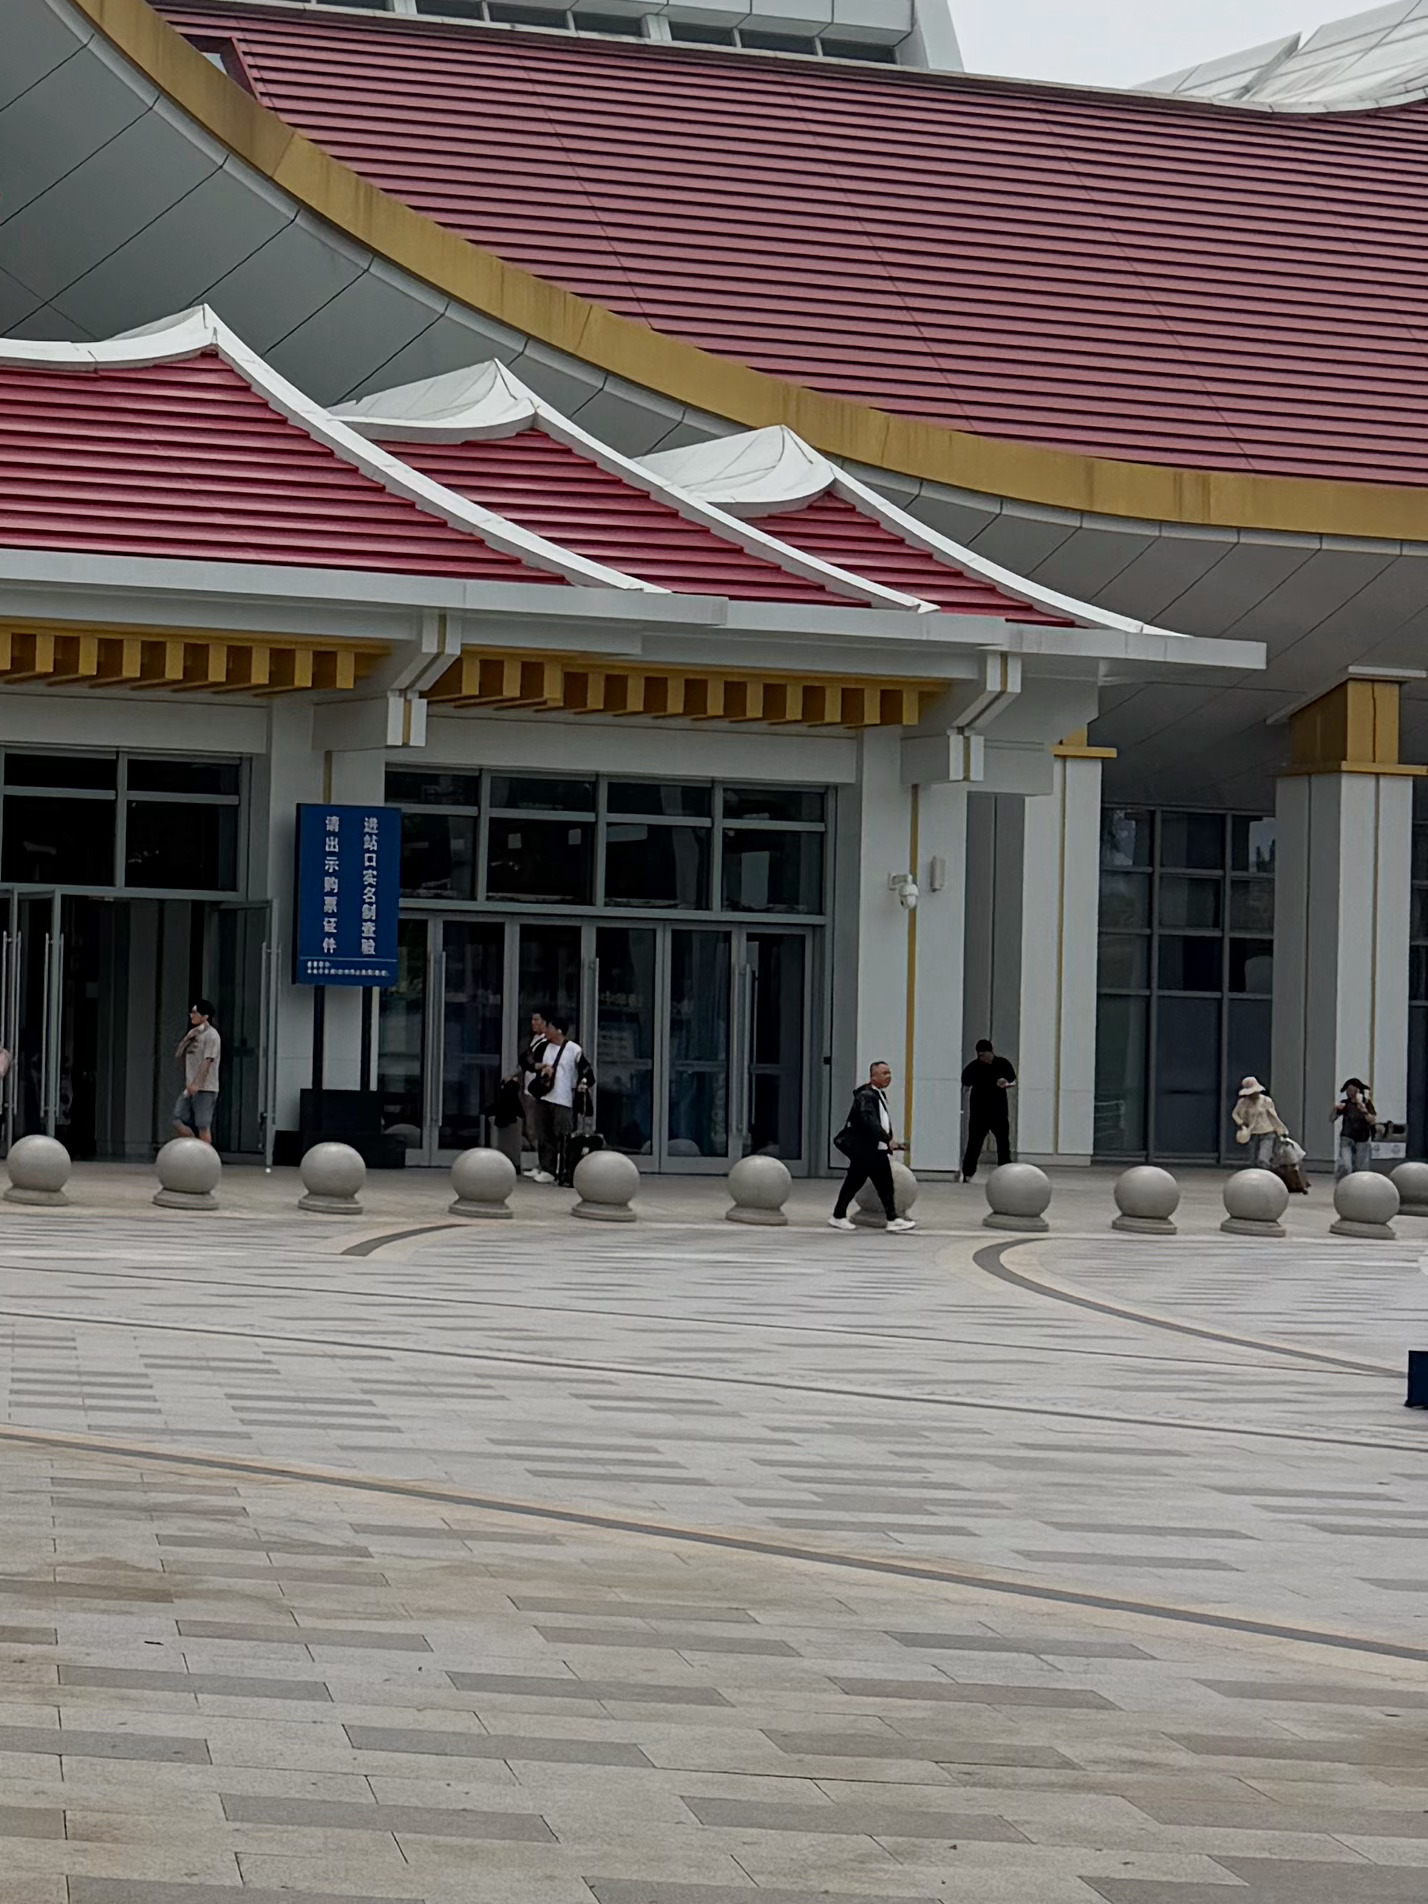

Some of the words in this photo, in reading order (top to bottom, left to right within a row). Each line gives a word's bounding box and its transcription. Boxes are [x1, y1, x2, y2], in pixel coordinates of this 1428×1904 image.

[322, 815, 340, 954] 请出示购票证件
[361, 816, 379, 955] 进站口实名制查验
